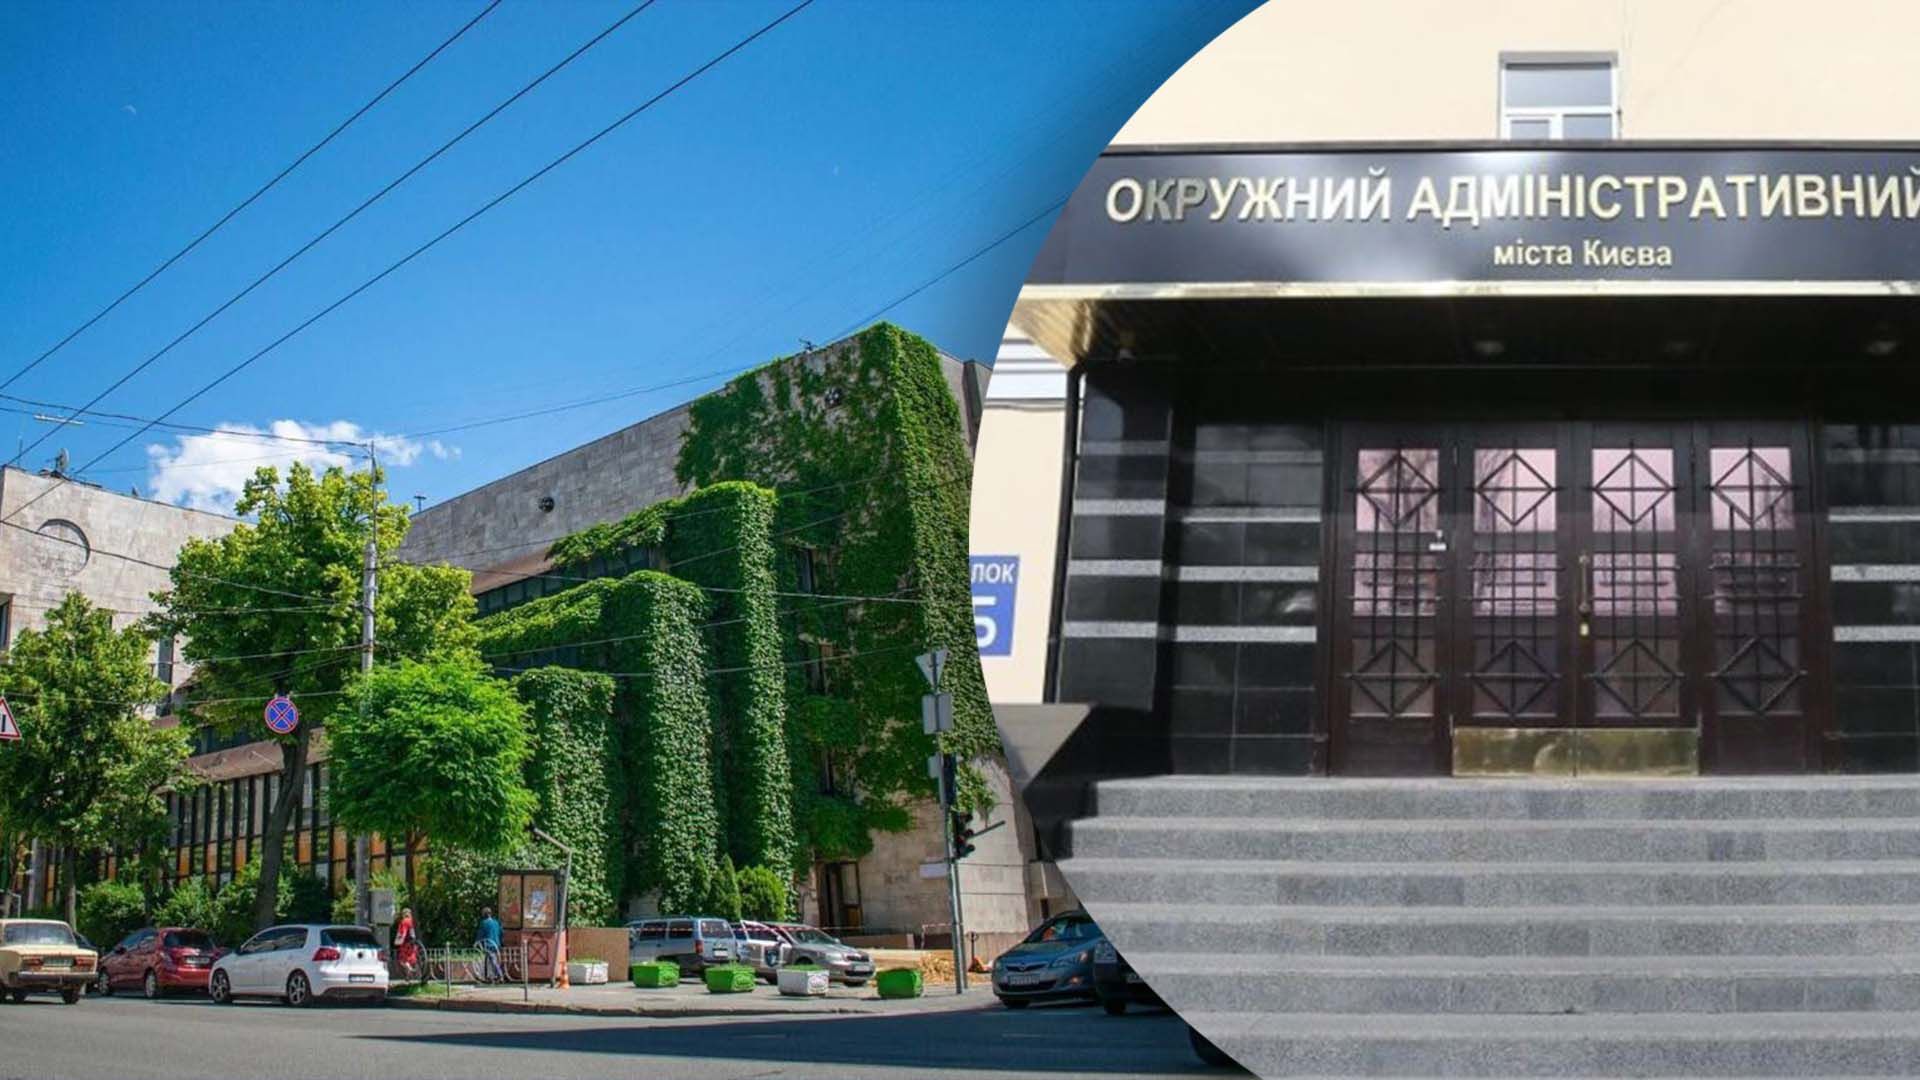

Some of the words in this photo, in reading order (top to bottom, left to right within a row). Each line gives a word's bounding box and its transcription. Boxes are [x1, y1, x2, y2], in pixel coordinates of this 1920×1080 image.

[1106, 166, 1392, 222] ОКРУЖНИЙ
[1493, 238, 1572, 266] міста
[1583, 239, 1672, 266] Києва
